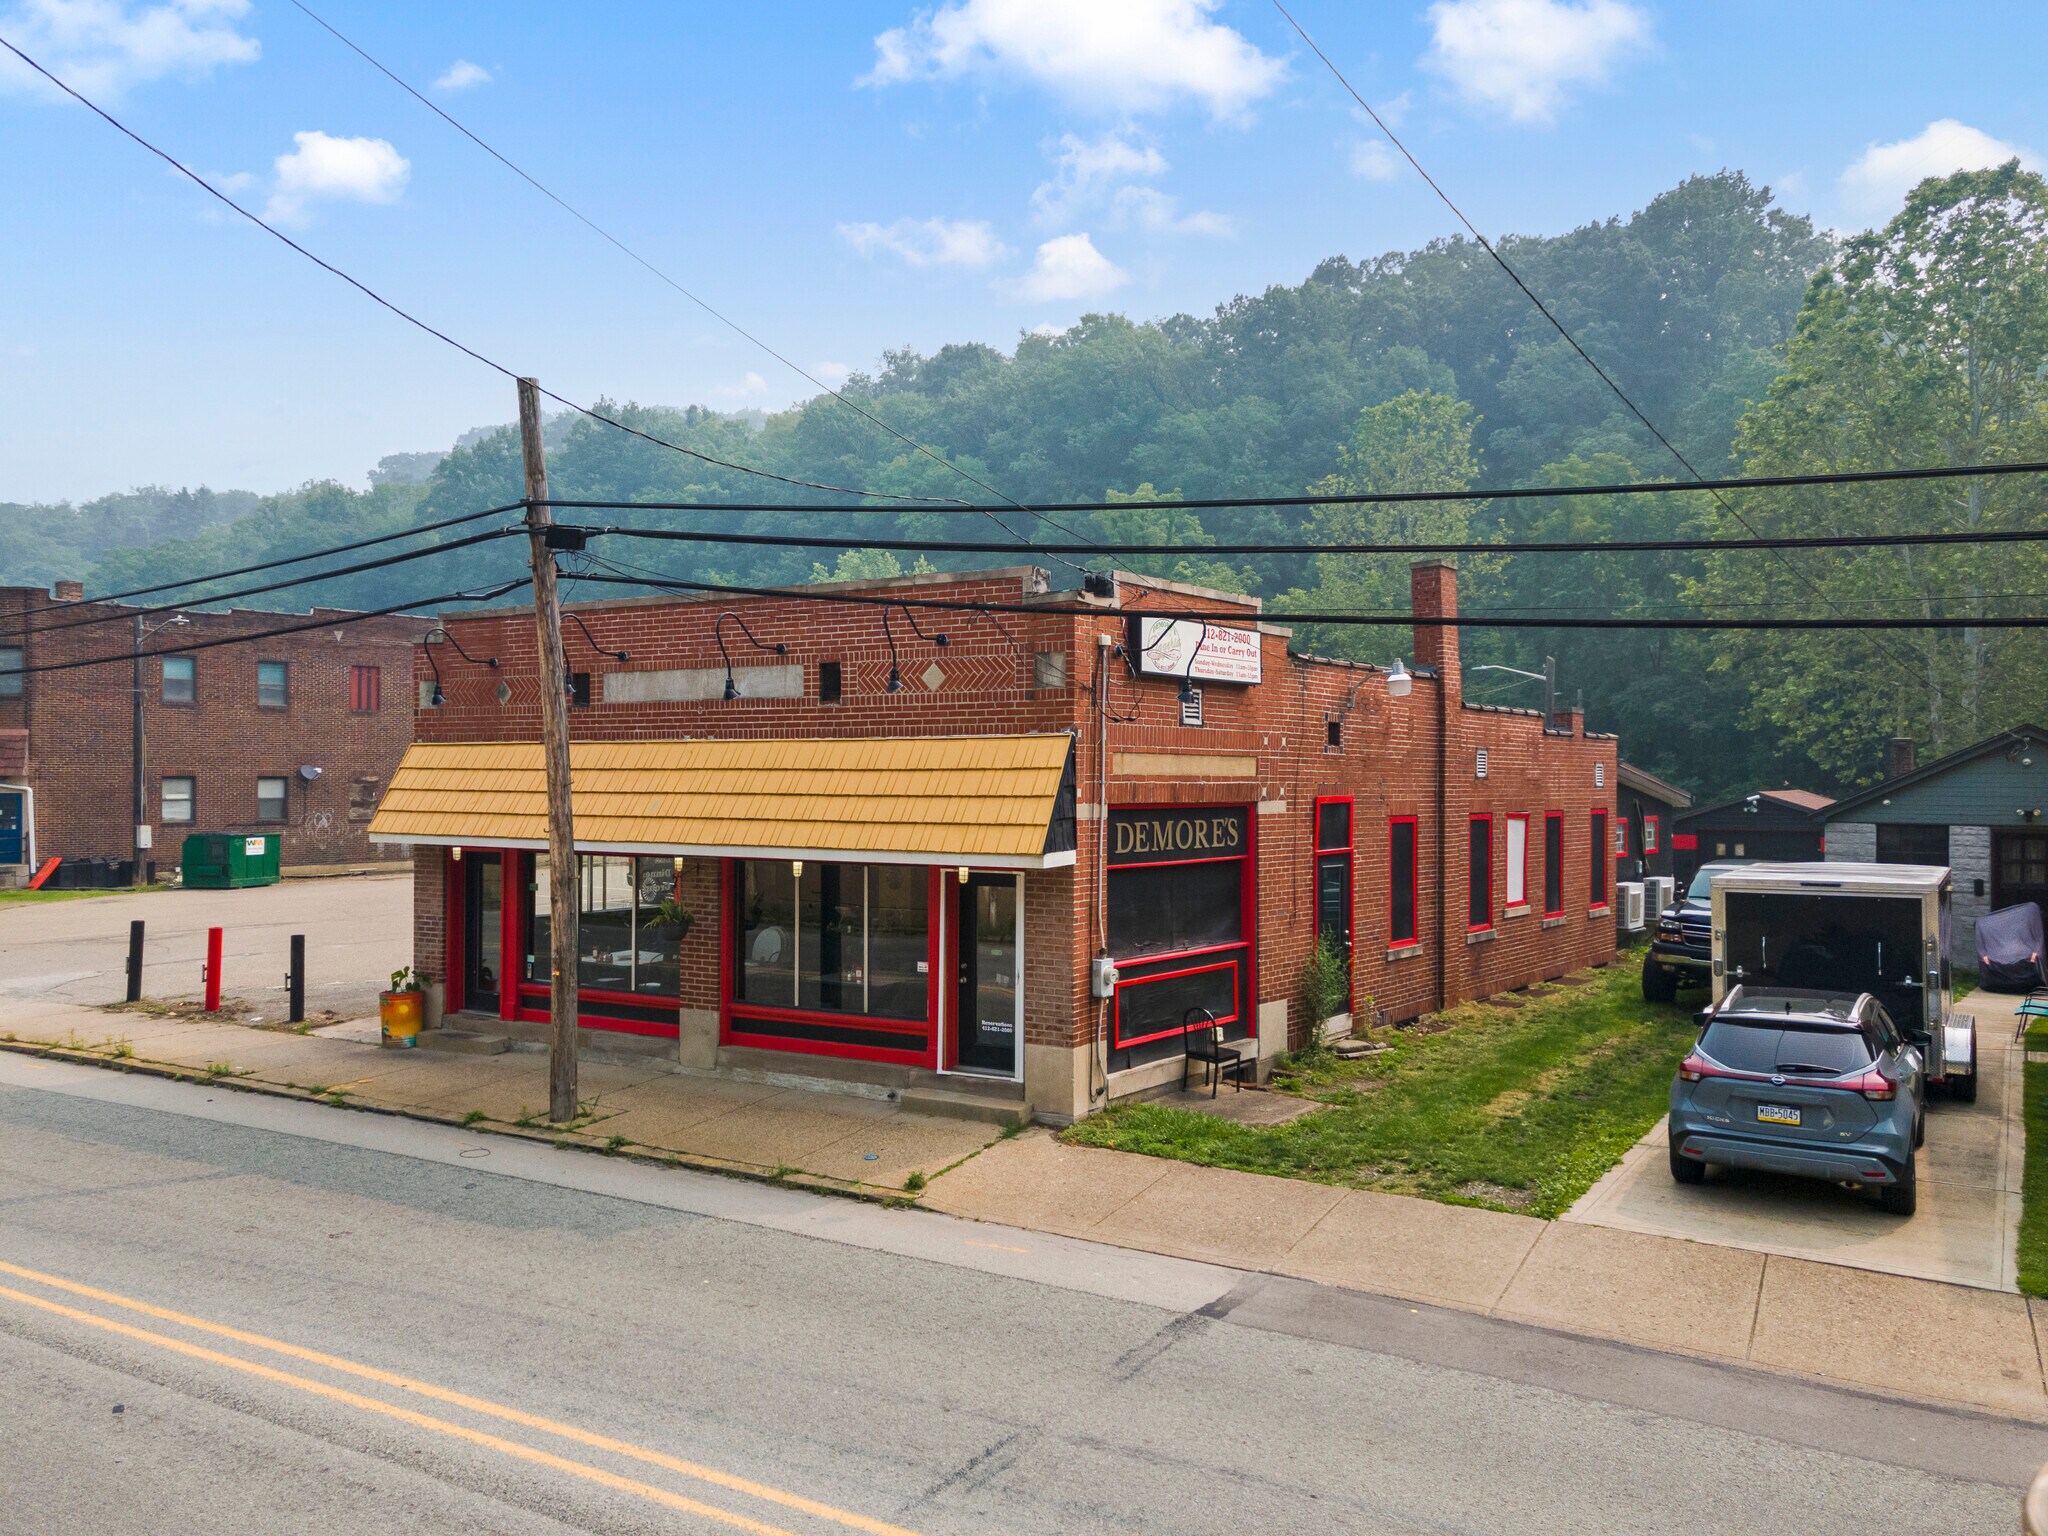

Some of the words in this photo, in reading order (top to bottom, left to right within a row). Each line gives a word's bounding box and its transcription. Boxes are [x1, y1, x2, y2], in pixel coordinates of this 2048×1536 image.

[1195, 640, 1210, 651] Dne
[1211, 643, 1219, 653] In
[1219, 646, 1226, 655] or
[1227, 645, 1245, 658] Carry
[1246, 648, 1258, 659] Out
[1115, 817, 1239, 854] DEMORE'S
